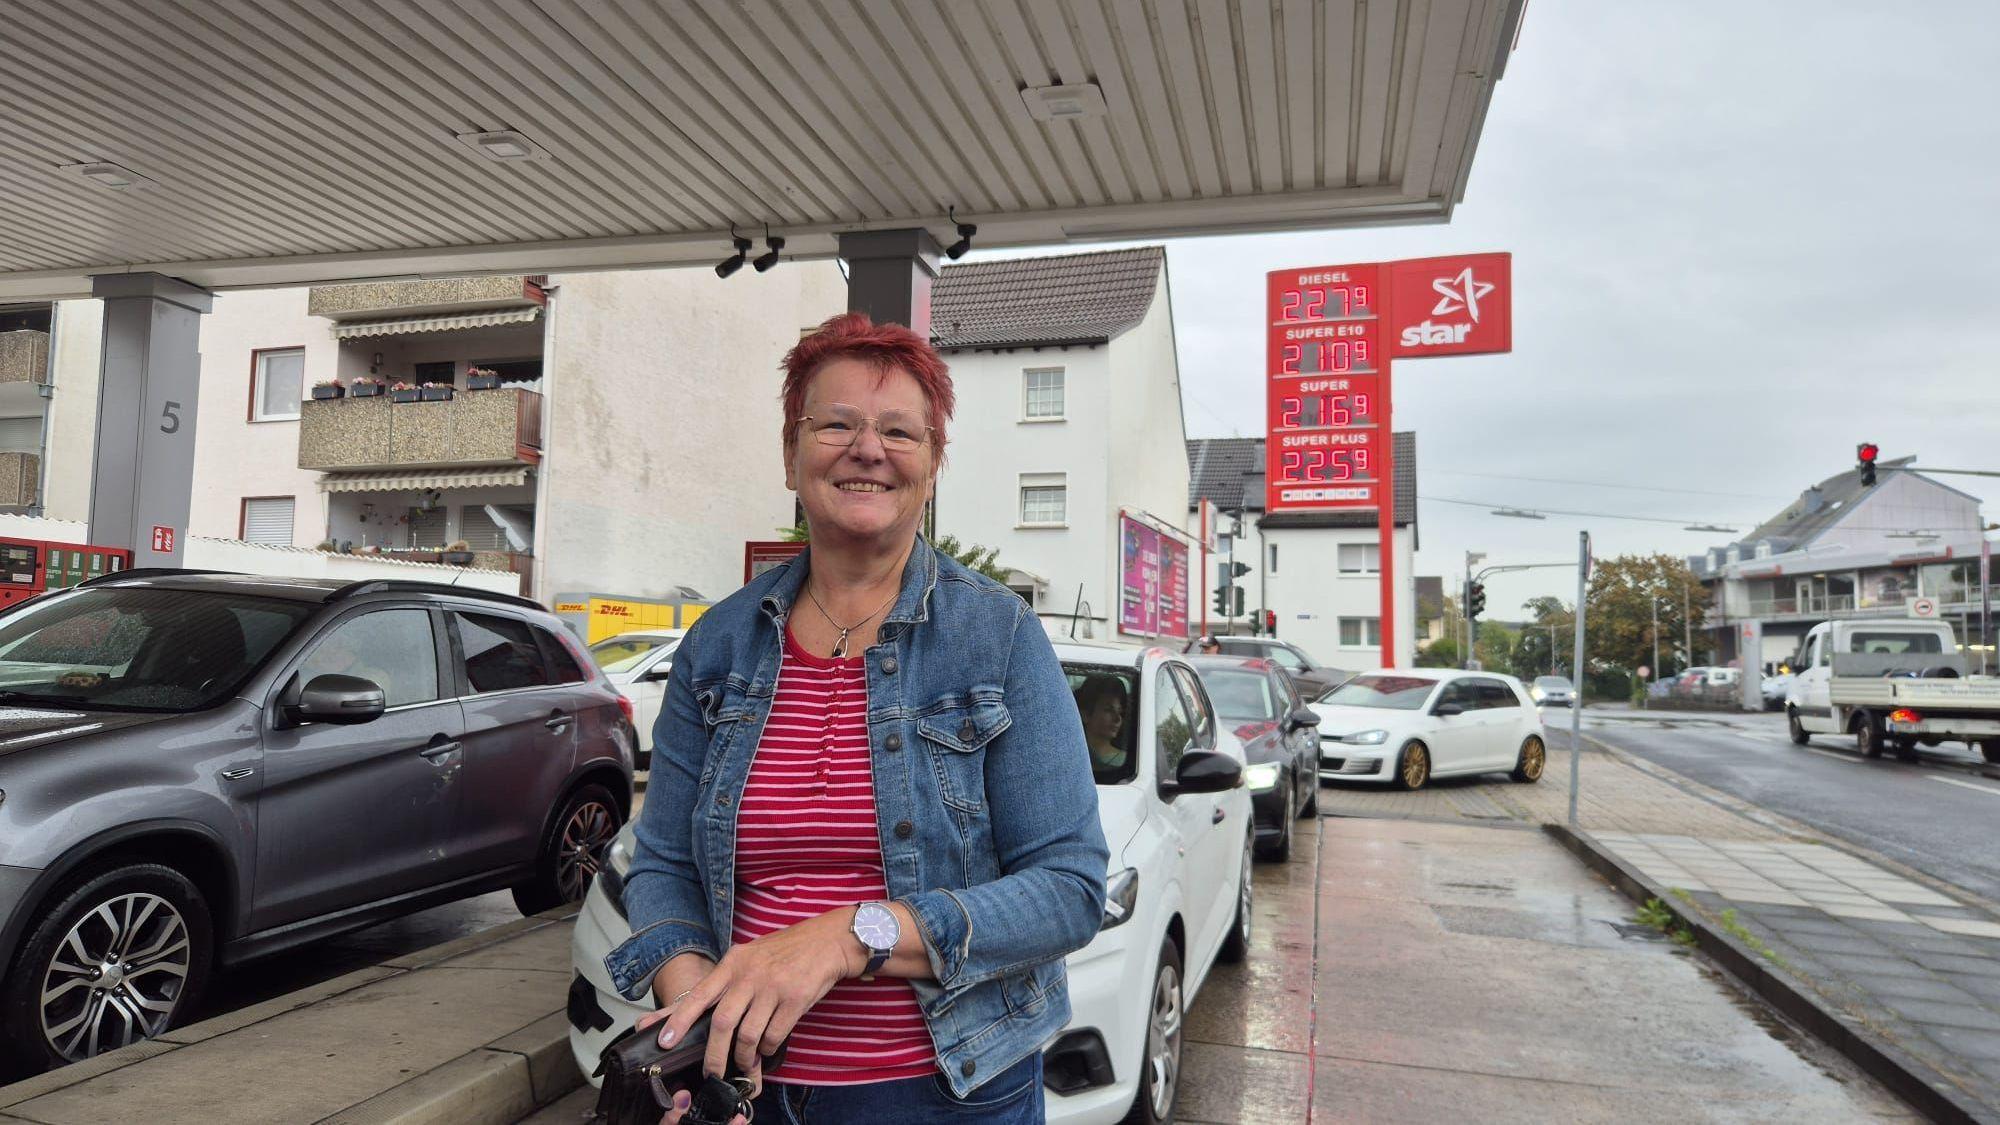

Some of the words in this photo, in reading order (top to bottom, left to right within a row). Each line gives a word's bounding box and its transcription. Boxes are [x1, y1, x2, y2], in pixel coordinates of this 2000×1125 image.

[1298, 272, 1350, 286] DIESEL
[1286, 326, 1335, 340] SUPER
[1337, 325, 1365, 337] E10
[1400, 320, 1472, 347] star
[1300, 380, 1350, 393] SUPER
[160, 400, 182, 434] 5
[1282, 435, 1328, 447] SUPER
[1331, 434, 1368, 444] PLUS
[600, 604, 628, 616] DHL
